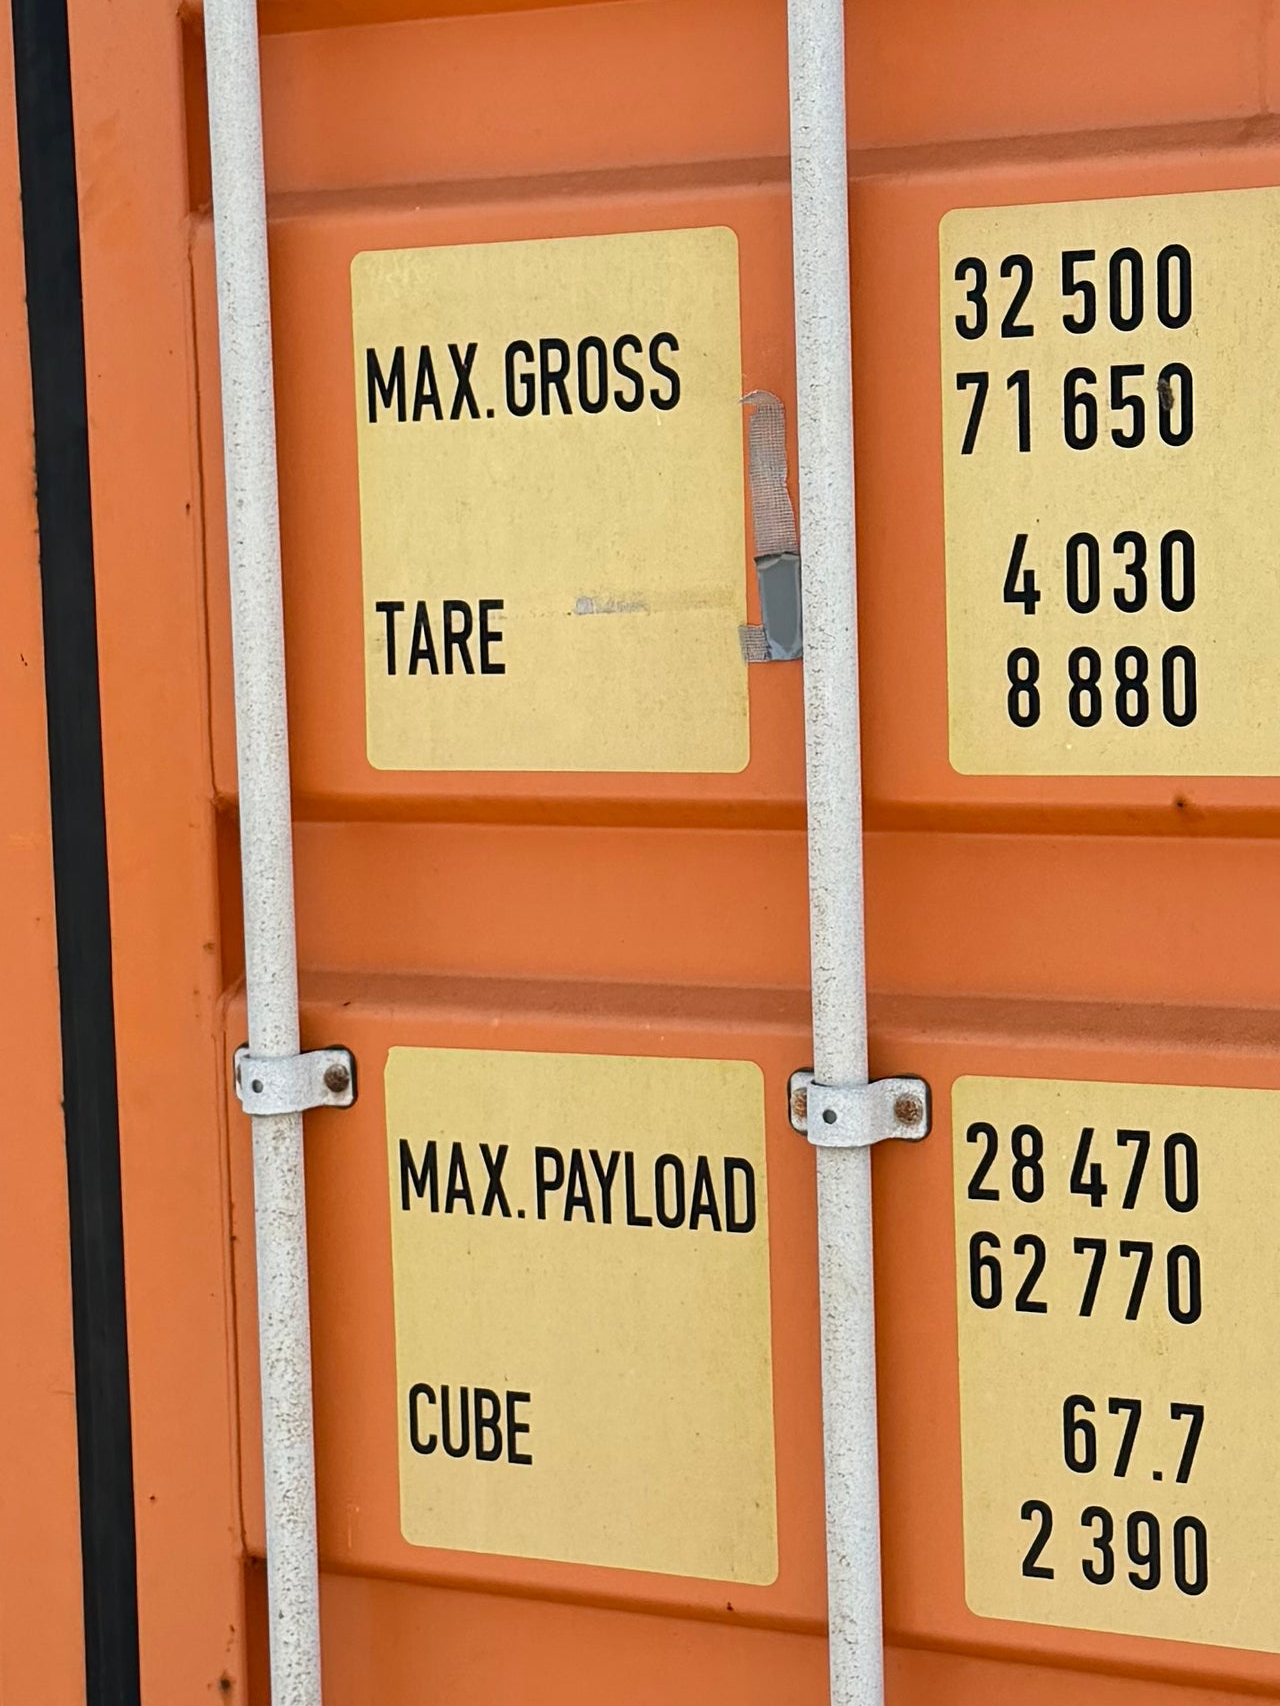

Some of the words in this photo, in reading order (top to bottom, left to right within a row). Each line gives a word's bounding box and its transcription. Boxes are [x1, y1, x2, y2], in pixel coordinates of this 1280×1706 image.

[376, 598, 507, 677] TARE
[408, 1382, 534, 1467] CUBE
[1062, 1394, 1205, 1484] 67.7
